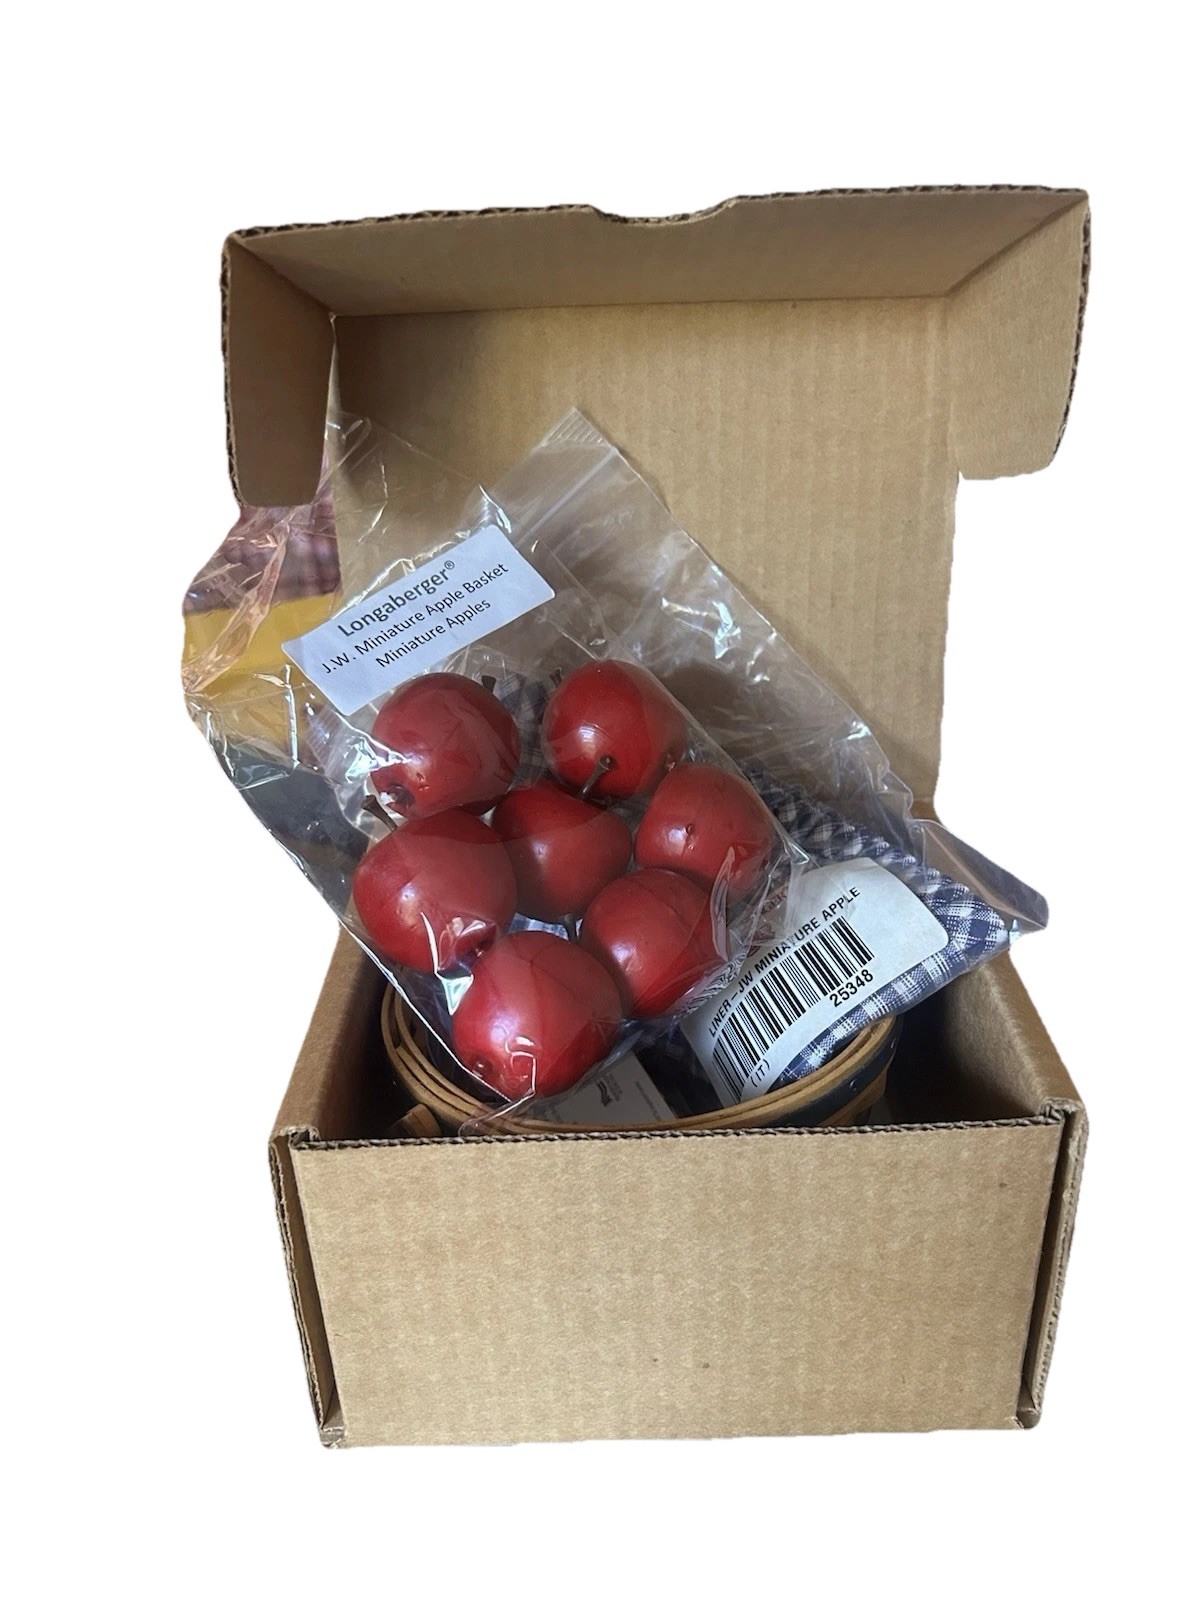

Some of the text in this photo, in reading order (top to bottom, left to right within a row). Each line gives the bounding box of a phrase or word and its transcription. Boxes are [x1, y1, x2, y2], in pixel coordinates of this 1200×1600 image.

[321, 563, 509, 674] J.W. Miniature Apple Basket
[375, 599, 491, 668] Miniature Apples
[822, 887, 861, 922] APPLE
[829, 969, 874, 1008] 25348
